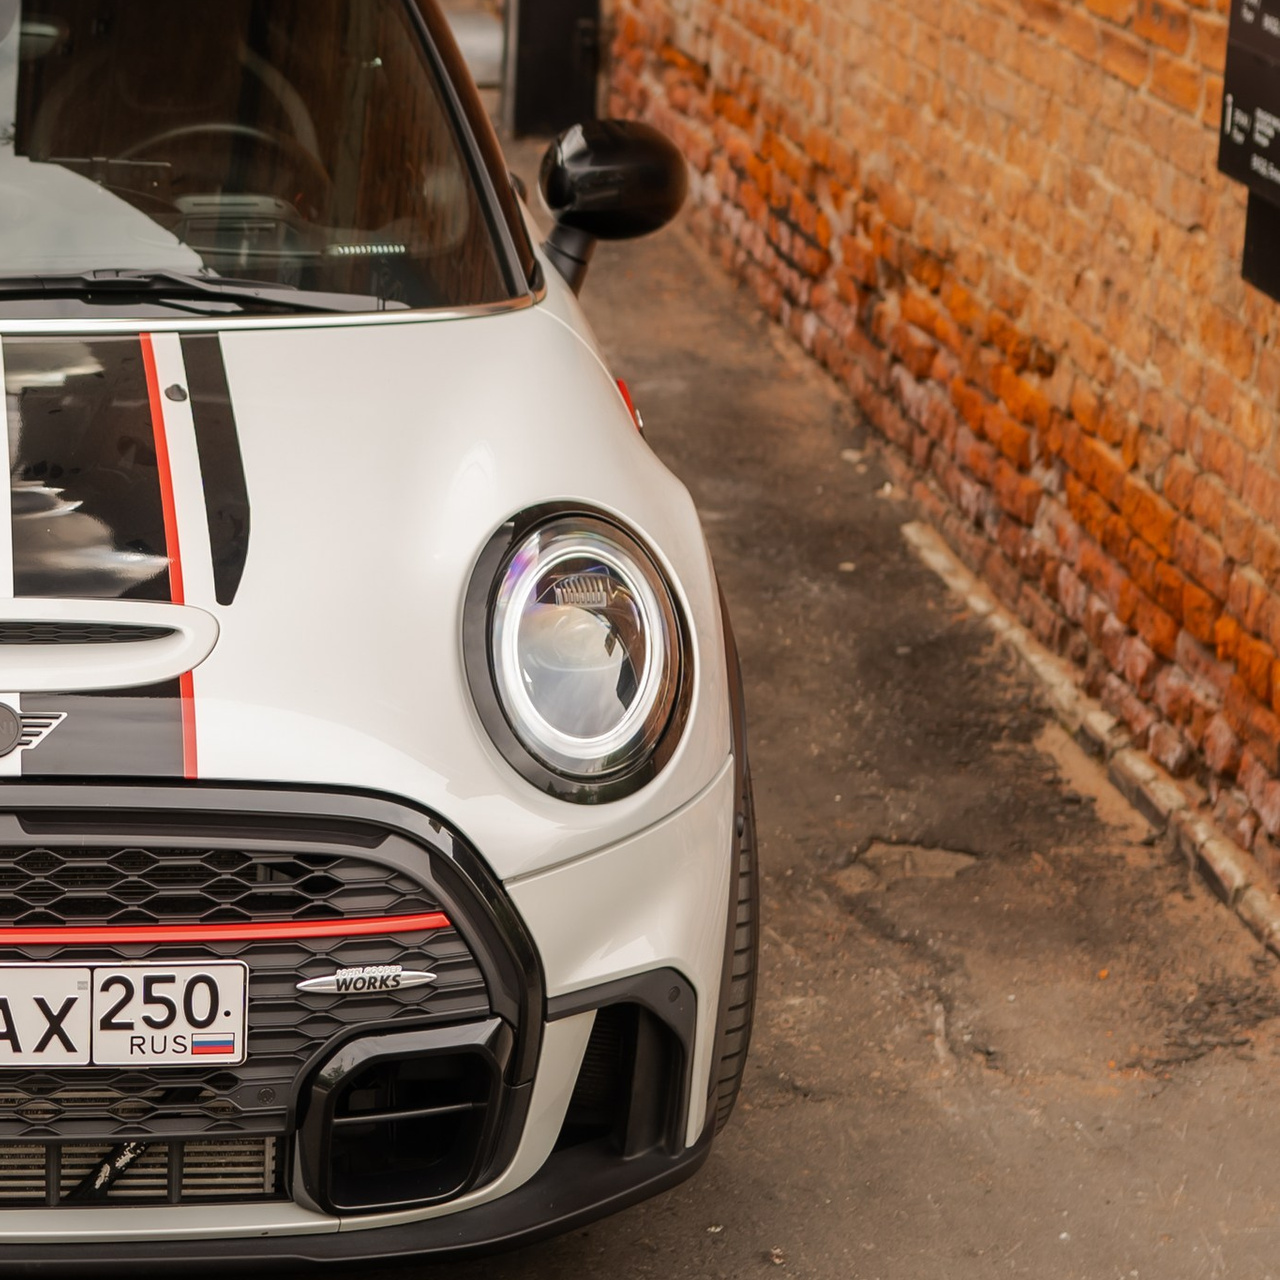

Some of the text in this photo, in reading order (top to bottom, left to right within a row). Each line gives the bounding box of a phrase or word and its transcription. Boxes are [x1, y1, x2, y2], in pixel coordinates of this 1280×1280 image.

[335, 964, 403, 978] JOHN COOPER
[336, 975, 401, 992] WORKS
[99, 973, 220, 1031] 250
[129, 1034, 188, 1055] RUS
